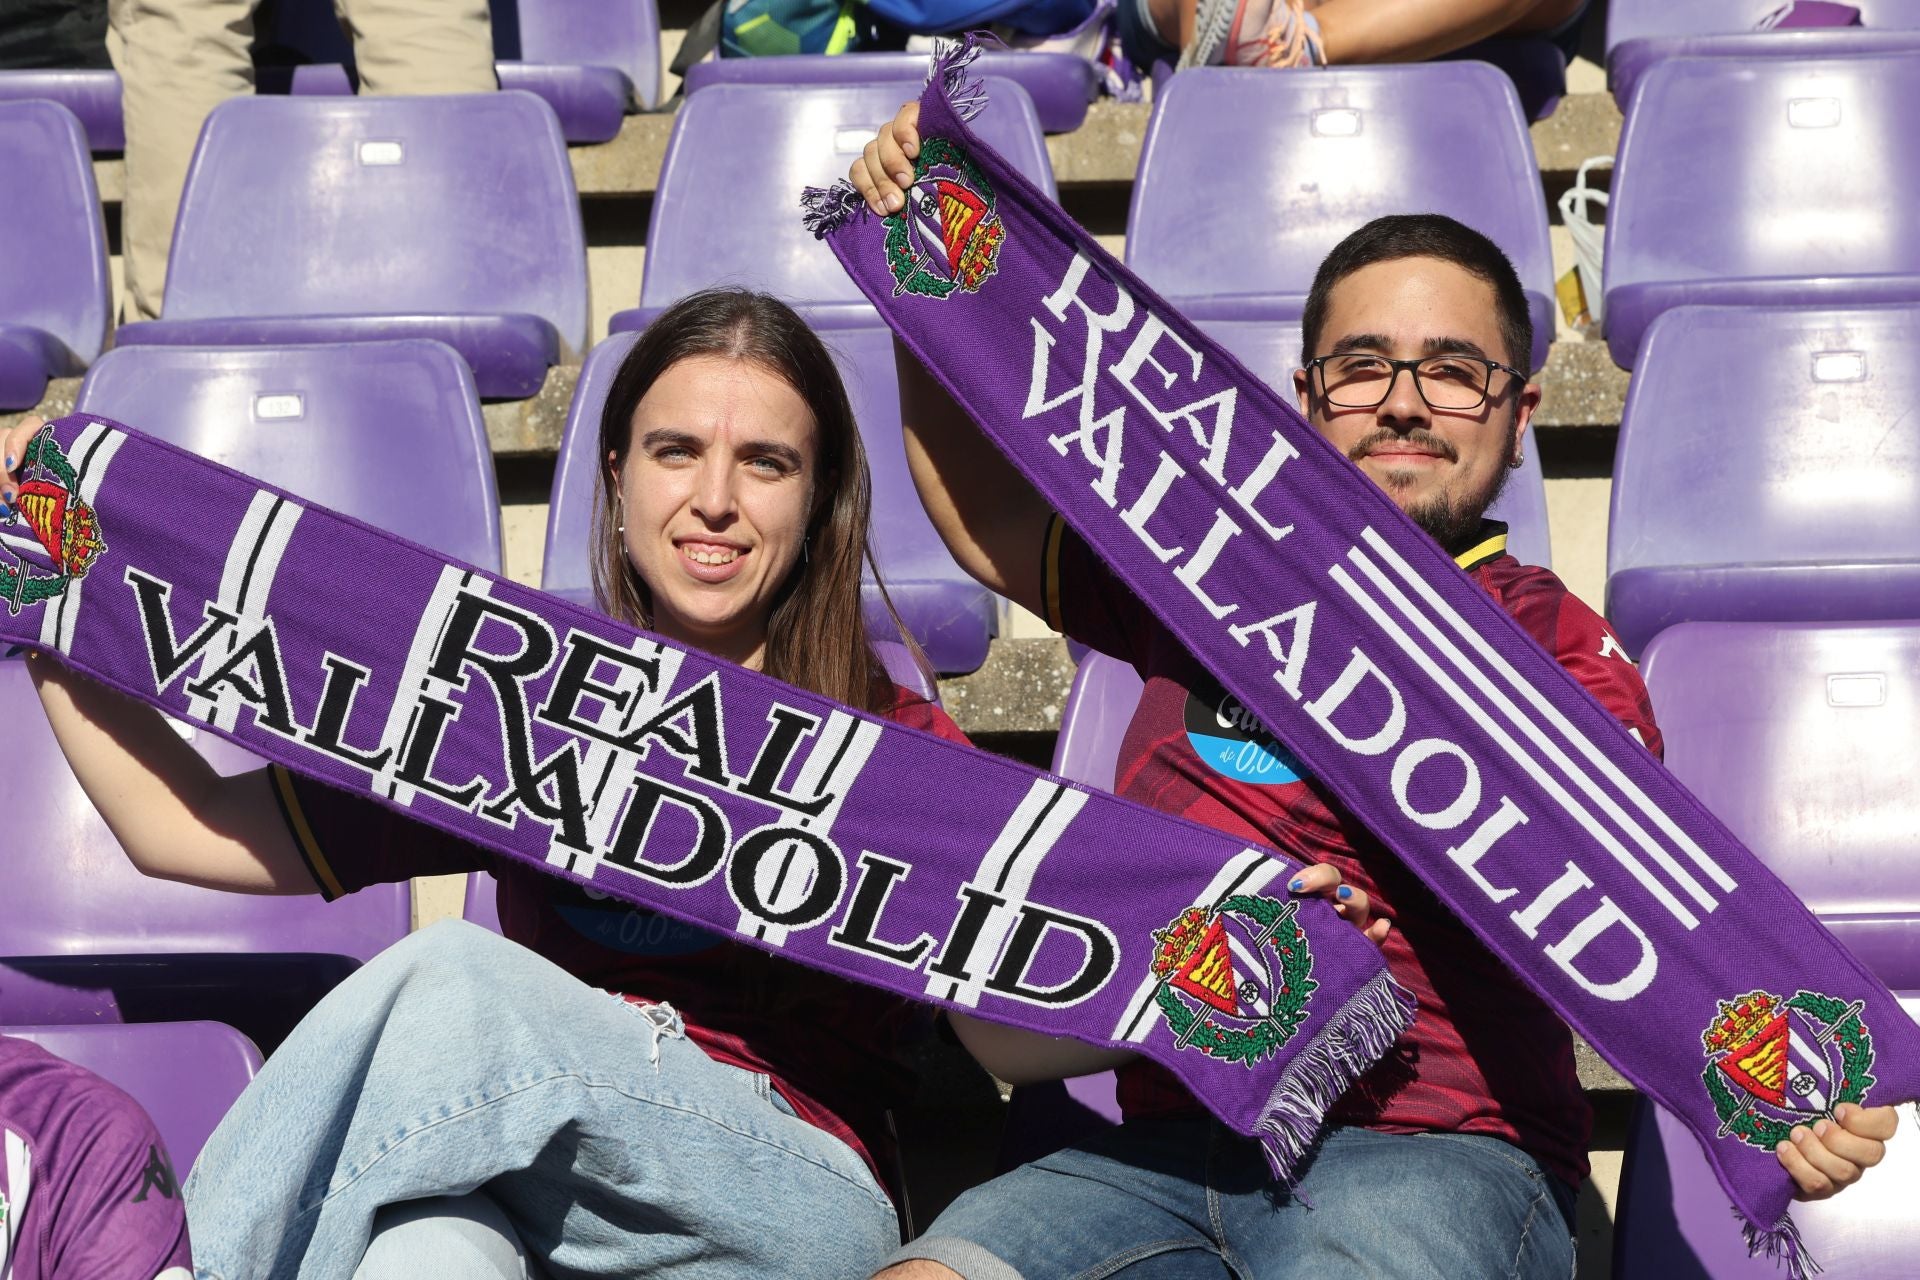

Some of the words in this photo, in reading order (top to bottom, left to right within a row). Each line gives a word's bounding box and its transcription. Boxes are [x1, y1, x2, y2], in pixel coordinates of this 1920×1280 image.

[1041, 245, 1301, 541] REAL
[124, 565, 1122, 1009] VALLADOLID
[425, 586, 837, 822] REAL
[1021, 317, 1660, 1001] VALLADOLID
